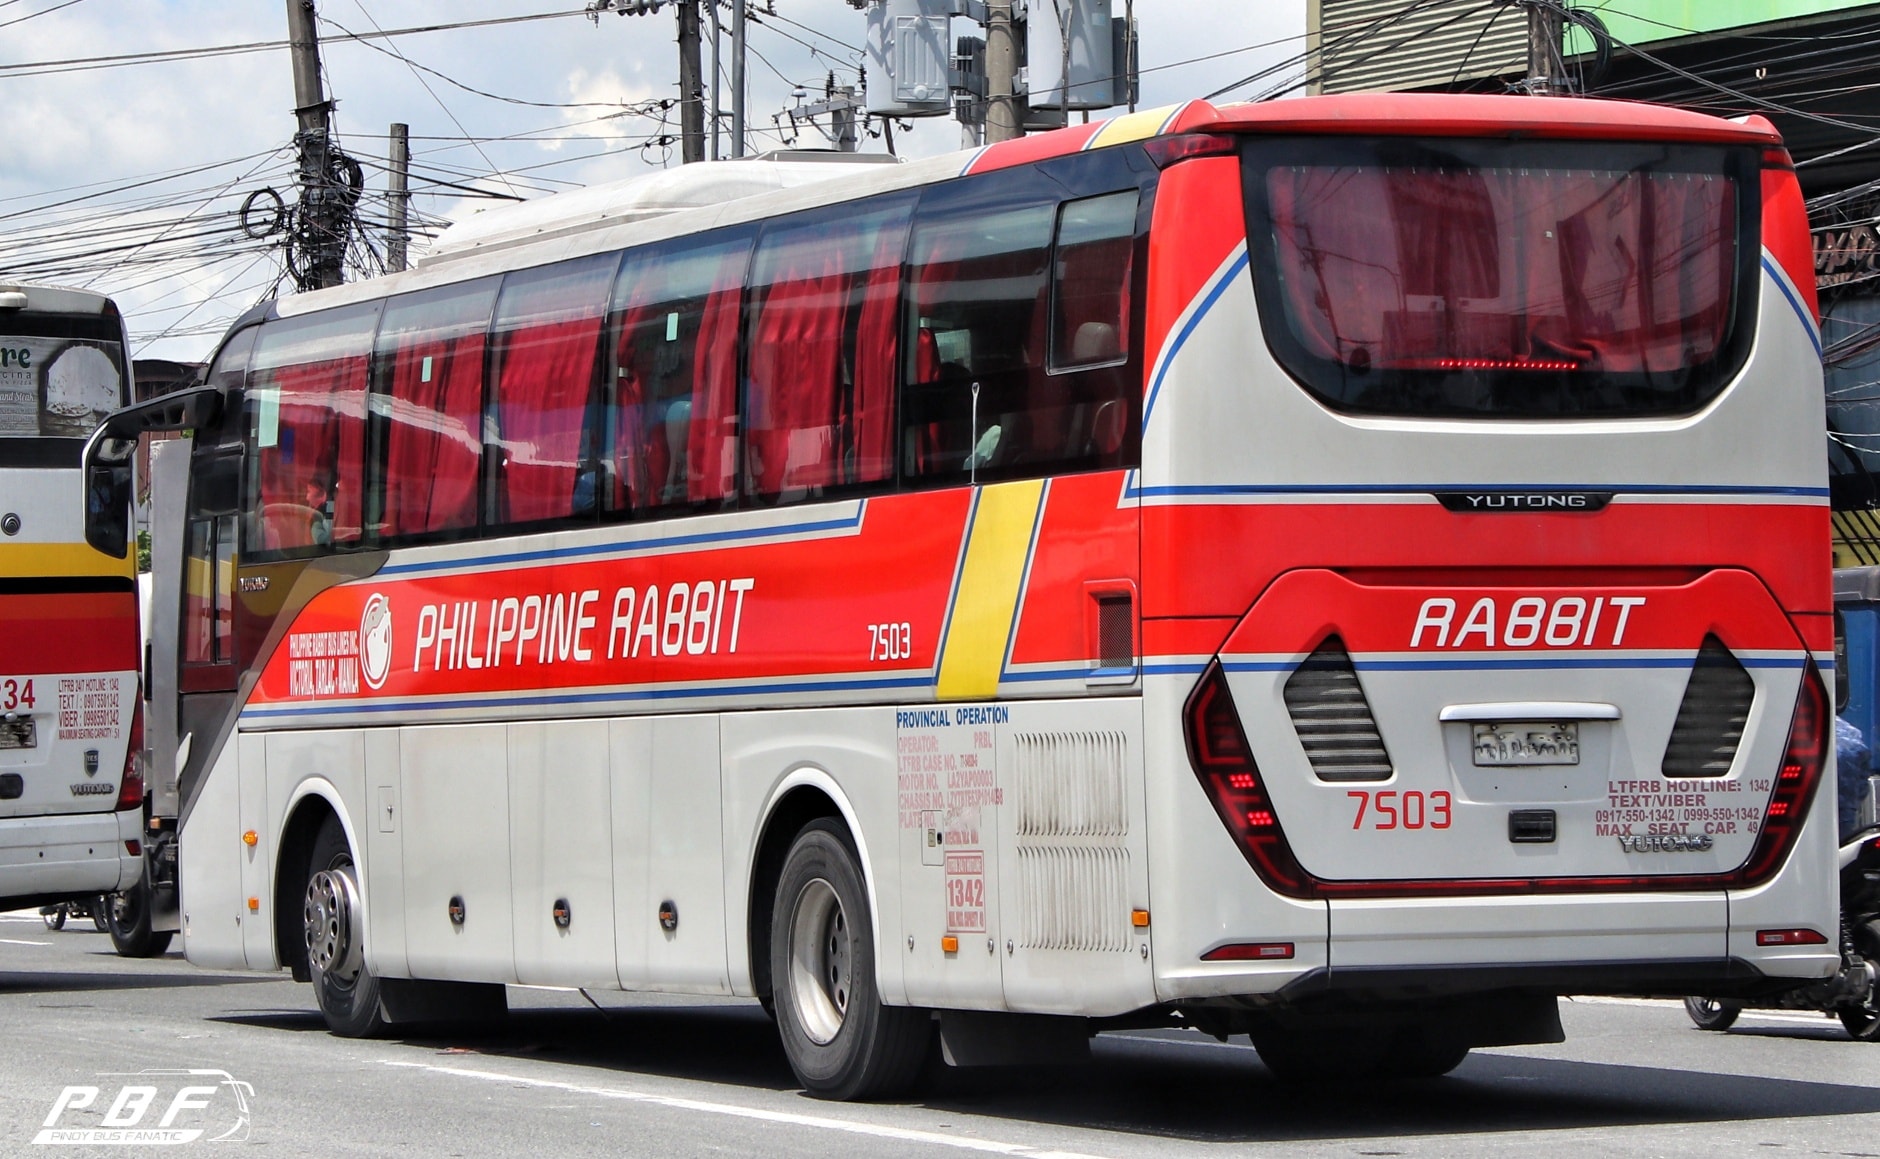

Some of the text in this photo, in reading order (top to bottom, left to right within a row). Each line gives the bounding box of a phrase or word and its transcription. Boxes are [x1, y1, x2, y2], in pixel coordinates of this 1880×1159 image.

[1466, 495, 1586, 507] YUTONG
[413, 577, 755, 673] PHILIPPINE RABBIT
[1410, 597, 1646, 647] RABBIT
[290, 632, 312, 658] PHILIPPINE
[313, 631, 328, 657] RABBIT
[328, 631, 337, 656] BUS
[868, 622, 911, 662] 7503
[316, 658, 334, 695] TARLAC
[339, 657, 359, 694] MANILA
[0, 679, 35, 710] 34
[59, 694, 74, 709] TEXT
[58, 710, 78, 728] VIBER
[897, 707, 1008, 728] PROVINCIAL OPERATION
[974, 731, 992, 748] PRBL
[898, 755, 921, 772] LTFRB
[923, 755, 942, 771] CASE
[944, 754, 957, 771] NO.
[899, 774, 925, 790] MOTOR
[1608, 779, 1770, 793] LTFRB HOTLINE: 1342
[899, 792, 931, 810] CHASSIS
[1346, 790, 1452, 830] 7503
[1608, 794, 1706, 808] TEXT/VIBER
[899, 811, 922, 829] PLATE
[1595, 809, 1675, 823] 0917-550-1342
[1683, 808, 1760, 821] 0999-550-1342
[1595, 821, 1758, 836] MAX SEAT CAP. 49
[1618, 833, 1713, 853] YUTONG
[948, 879, 983, 907] 1342
